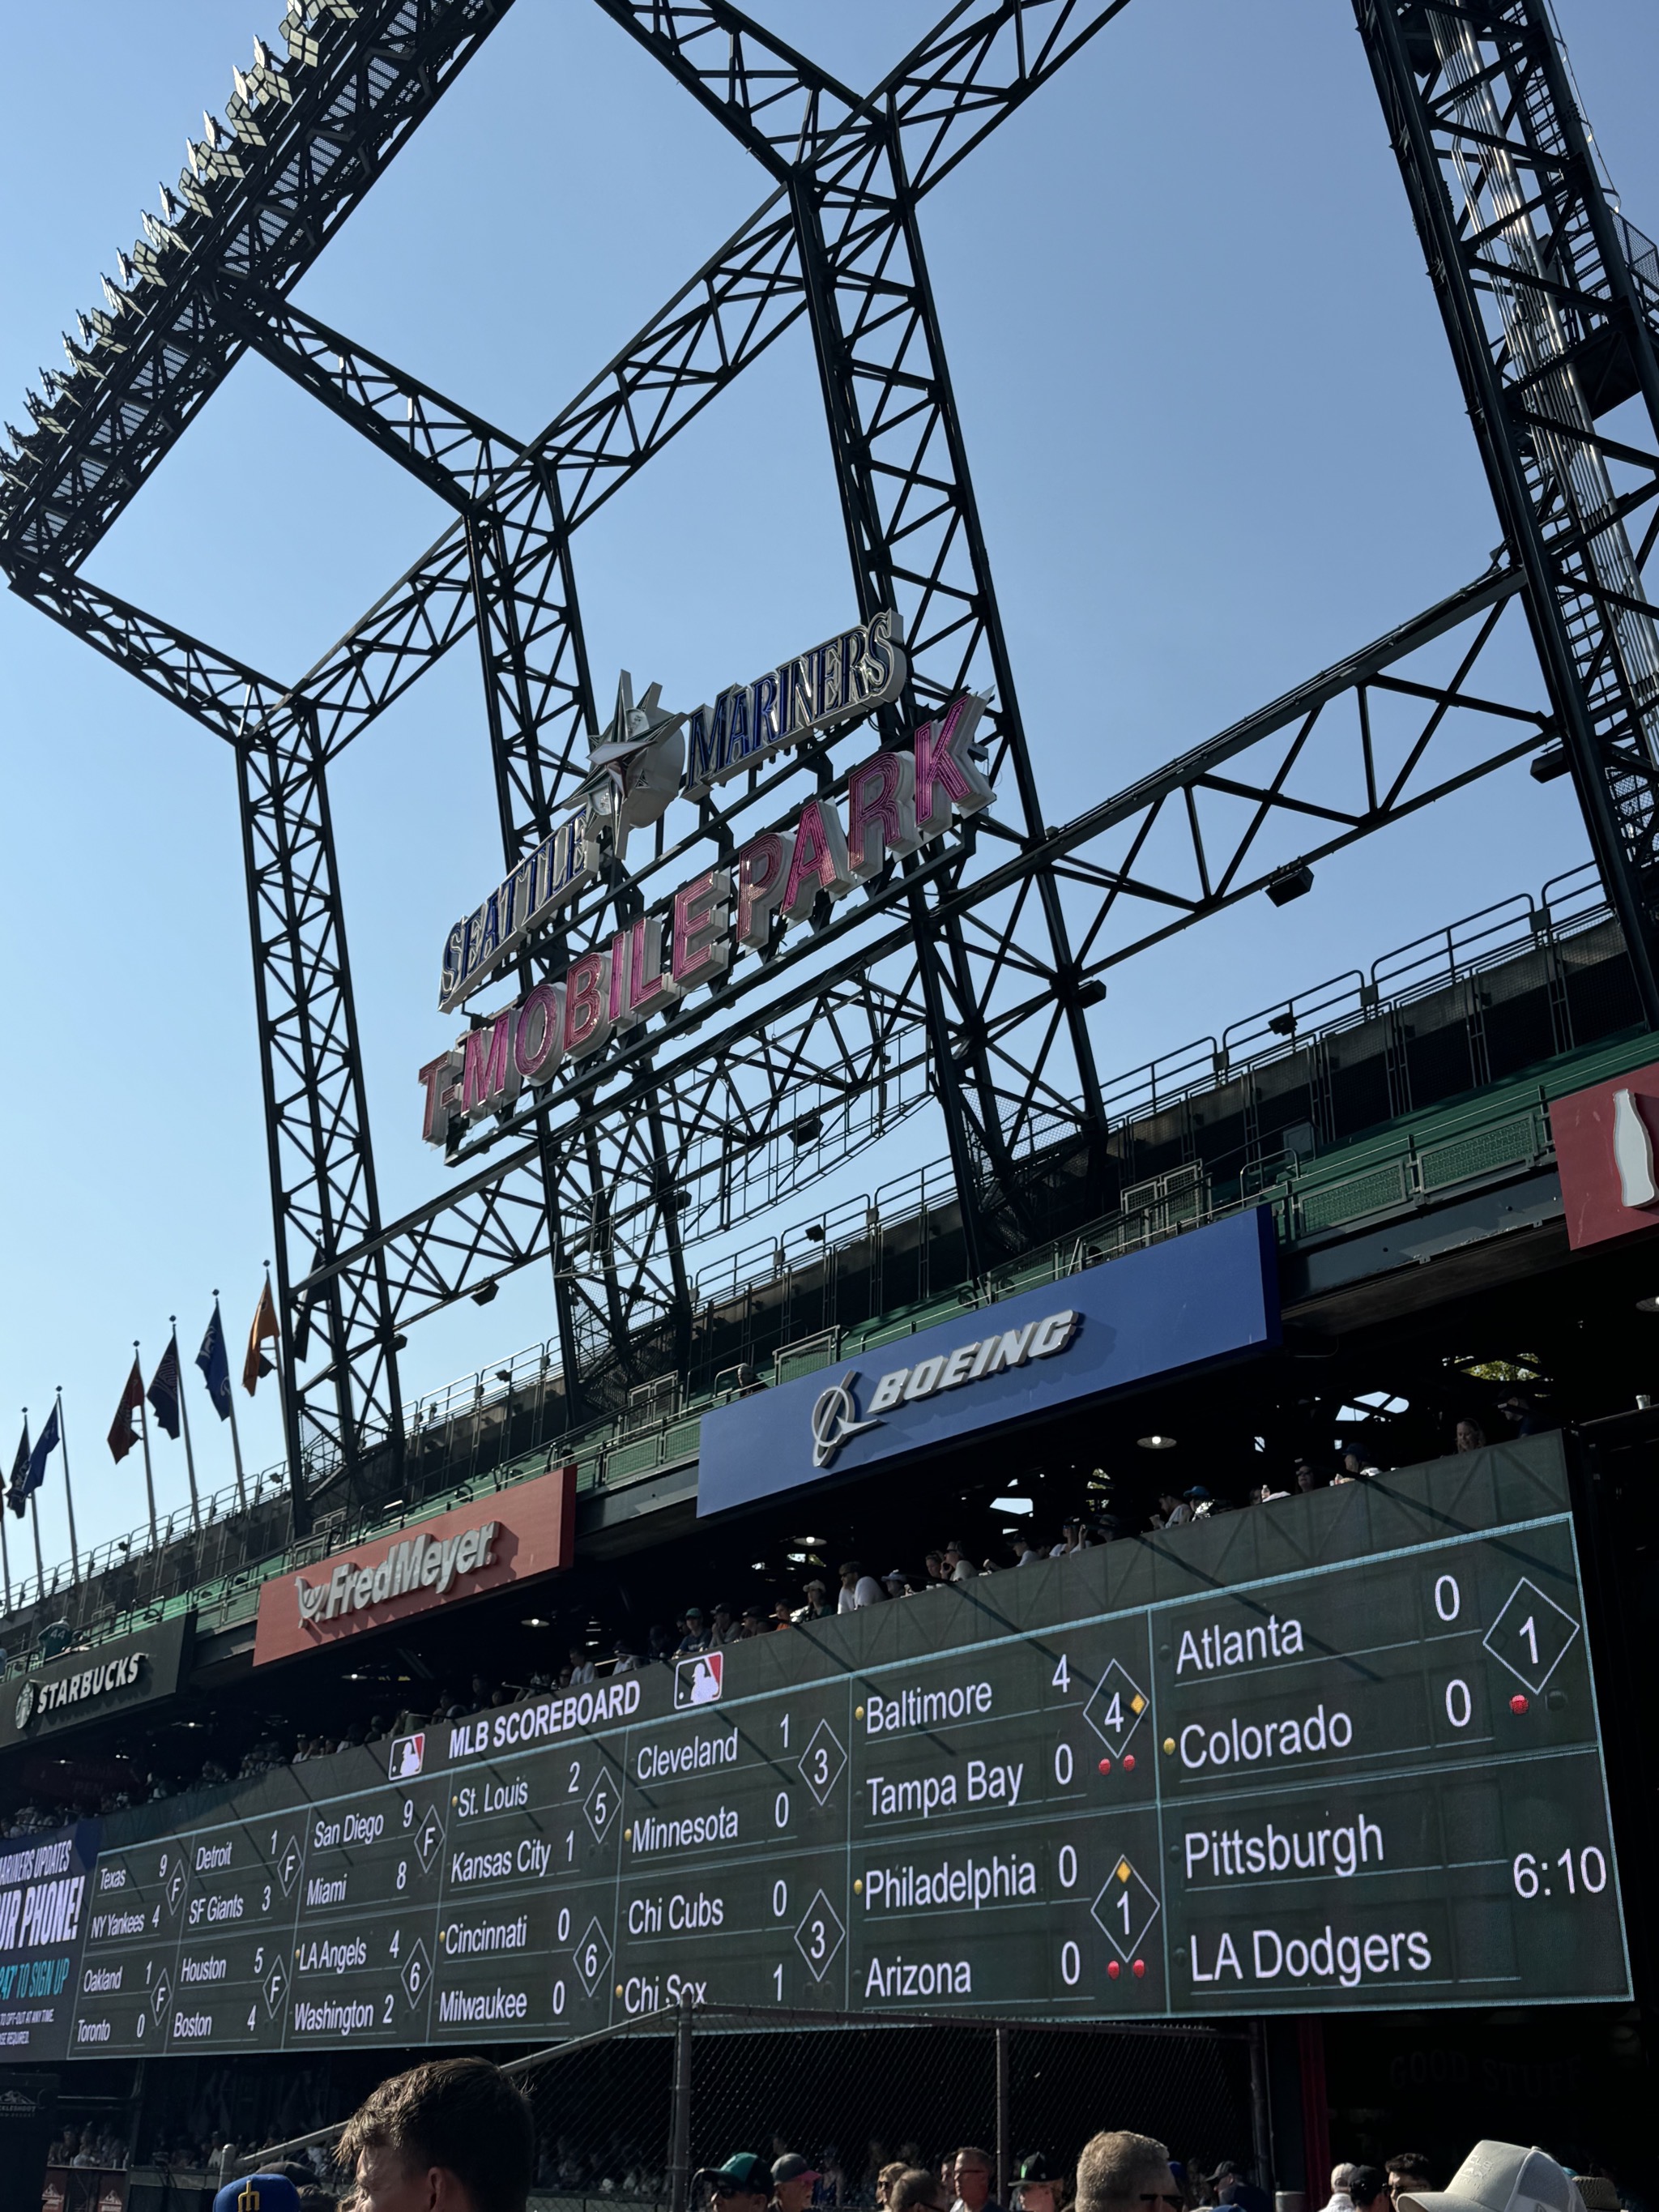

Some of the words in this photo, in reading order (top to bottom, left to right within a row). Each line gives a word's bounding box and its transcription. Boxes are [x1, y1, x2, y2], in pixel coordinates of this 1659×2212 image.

[684, 611, 901, 794] MARINERS
[418, 873, 719, 1142] T-MOBILE
[736, 690, 982, 945] PARK
[438, 810, 595, 1010] SEATTLE
[868, 1309, 1078, 1414] BOEING
[1176, 1614, 1304, 1675] Atlanta
[1435, 1574, 1461, 1621] 0
[1519, 1616, 1538, 1664] 1
[37, 1653, 146, 1714] STARBUCKS
[867, 1682, 992, 1734] Baltimore
[1051, 1654, 1071, 1693] 4
[448, 1720, 489, 1759] MLB
[493, 1680, 641, 1749] SCOREBOARD
[1104, 1692, 1124, 1733] 4
[1179, 1704, 1353, 1769] Colorado
[1445, 1679, 1472, 1727] 0
[637, 1727, 738, 1780] Cleveland
[780, 1713, 789, 1749] 1
[813, 1748, 829, 1785] 3
[458, 1787, 479, 1817] St.
[484, 1782, 528, 1813] Louis
[568, 1761, 581, 1793] 2
[866, 1774, 957, 1819] Tampa
[967, 1760, 1024, 1807] Bay
[1055, 1743, 1073, 1785] 0
[313, 1821, 341, 1848] San
[343, 1813, 384, 1845] Diego
[403, 1799, 414, 1828] 9
[595, 1791, 607, 1825] 5
[632, 1806, 739, 1853] Minnesota
[774, 1791, 789, 1828] 0
[33, 1839, 72, 1879] UPDATES
[195, 1841, 232, 1871] Detroit
[271, 1830, 278, 1855] 1
[423, 1826, 436, 1857] F
[450, 1846, 513, 1883] Kansas
[517, 1838, 552, 1878] City
[565, 1830, 574, 1862] 1
[1185, 1813, 1384, 1879] Pittsburgh
[100, 1868, 126, 1890] Texas
[159, 1854, 168, 1878] 9
[171, 1877, 181, 1902] F
[284, 1855, 296, 1882] F
[306, 1873, 348, 1907] Miami
[396, 1860, 407, 1890] 8
[865, 1853, 1037, 1911] Philadelphia
[1058, 1844, 1077, 1888] 0
[1513, 1846, 1607, 1898] 6:10
[18, 1875, 85, 1949] PHONE!
[91, 1915, 107, 1939] NY
[107, 1911, 145, 1936] Yankees
[151, 1905, 160, 1928] 4
[188, 1898, 207, 1924] SF
[207, 1894, 244, 1922] Giants
[261, 1885, 271, 1911] 3
[628, 1897, 663, 1935] Chi
[668, 1892, 724, 1930] Cubs
[773, 1879, 787, 1917] 0
[1116, 1890, 1130, 1935] 1
[299, 1941, 318, 1971] LA
[318, 1937, 367, 1975] Angels
[389, 1929, 400, 1958] 4
[446, 1915, 527, 1955] Cincinnati
[557, 1907, 570, 1941] 0
[810, 1920, 825, 1959] 3
[16, 1962, 30, 1999] TO
[28, 1959, 55, 1998] SIGN
[53, 1958, 70, 1996] UP
[83, 1966, 123, 1992] Oakland
[146, 1961, 152, 1985] 1
[180, 1955, 227, 1983] Houston
[254, 1947, 264, 1974] 5
[409, 1962, 421, 1992] 6
[585, 1943, 598, 1978] 6
[864, 1956, 971, 1998] Arizona
[1061, 1941, 1081, 1985] 0
[1190, 1932, 1243, 1982] LA
[1252, 1925, 1431, 1988] Dodgers
[156, 1987, 167, 2012] F
[269, 1975, 281, 2004] F
[439, 1987, 527, 2022] Milwaukee
[552, 1980, 565, 2015] 0
[625, 1975, 659, 2013] Chi
[666, 1974, 707, 2006] Sox
[773, 1963, 783, 2001] 1
[77, 2018, 111, 2043] Toronto
[136, 2013, 146, 2039] 0
[173, 2012, 212, 2038] Boston
[246, 2005, 257, 2031] 4
[294, 2000, 374, 2036] Washington
[382, 1993, 394, 2024] 2
[1389, 2048, 1470, 2091] GOOD
[1481, 2053, 1582, 2099] STUFF
